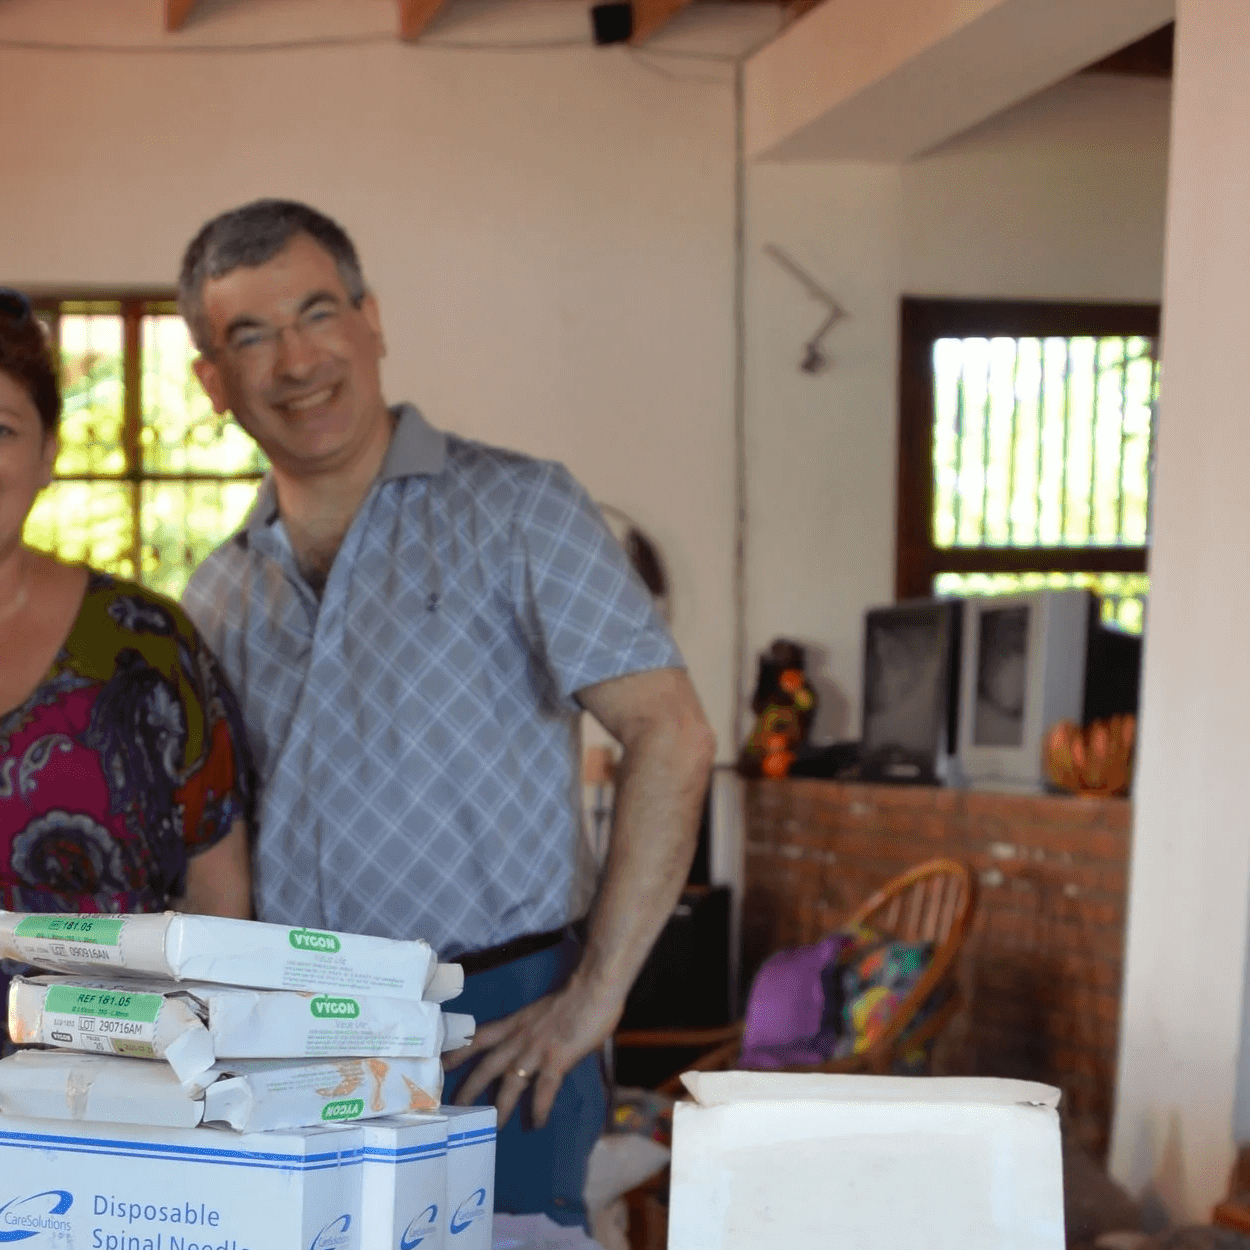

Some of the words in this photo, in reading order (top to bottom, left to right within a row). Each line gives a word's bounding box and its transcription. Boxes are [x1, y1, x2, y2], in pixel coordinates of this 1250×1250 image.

[294, 933, 336, 950] VYGON
[78, 993, 96, 1004] REF
[98, 994, 132, 1007] 181.05
[315, 1002, 356, 1014] VYGON
[79, 1018, 95, 1031] LOT
[99, 1020, 143, 1035] 290716AM
[93, 1194, 220, 1227] Disposable
[4, 1210, 72, 1231] CareSolutions
